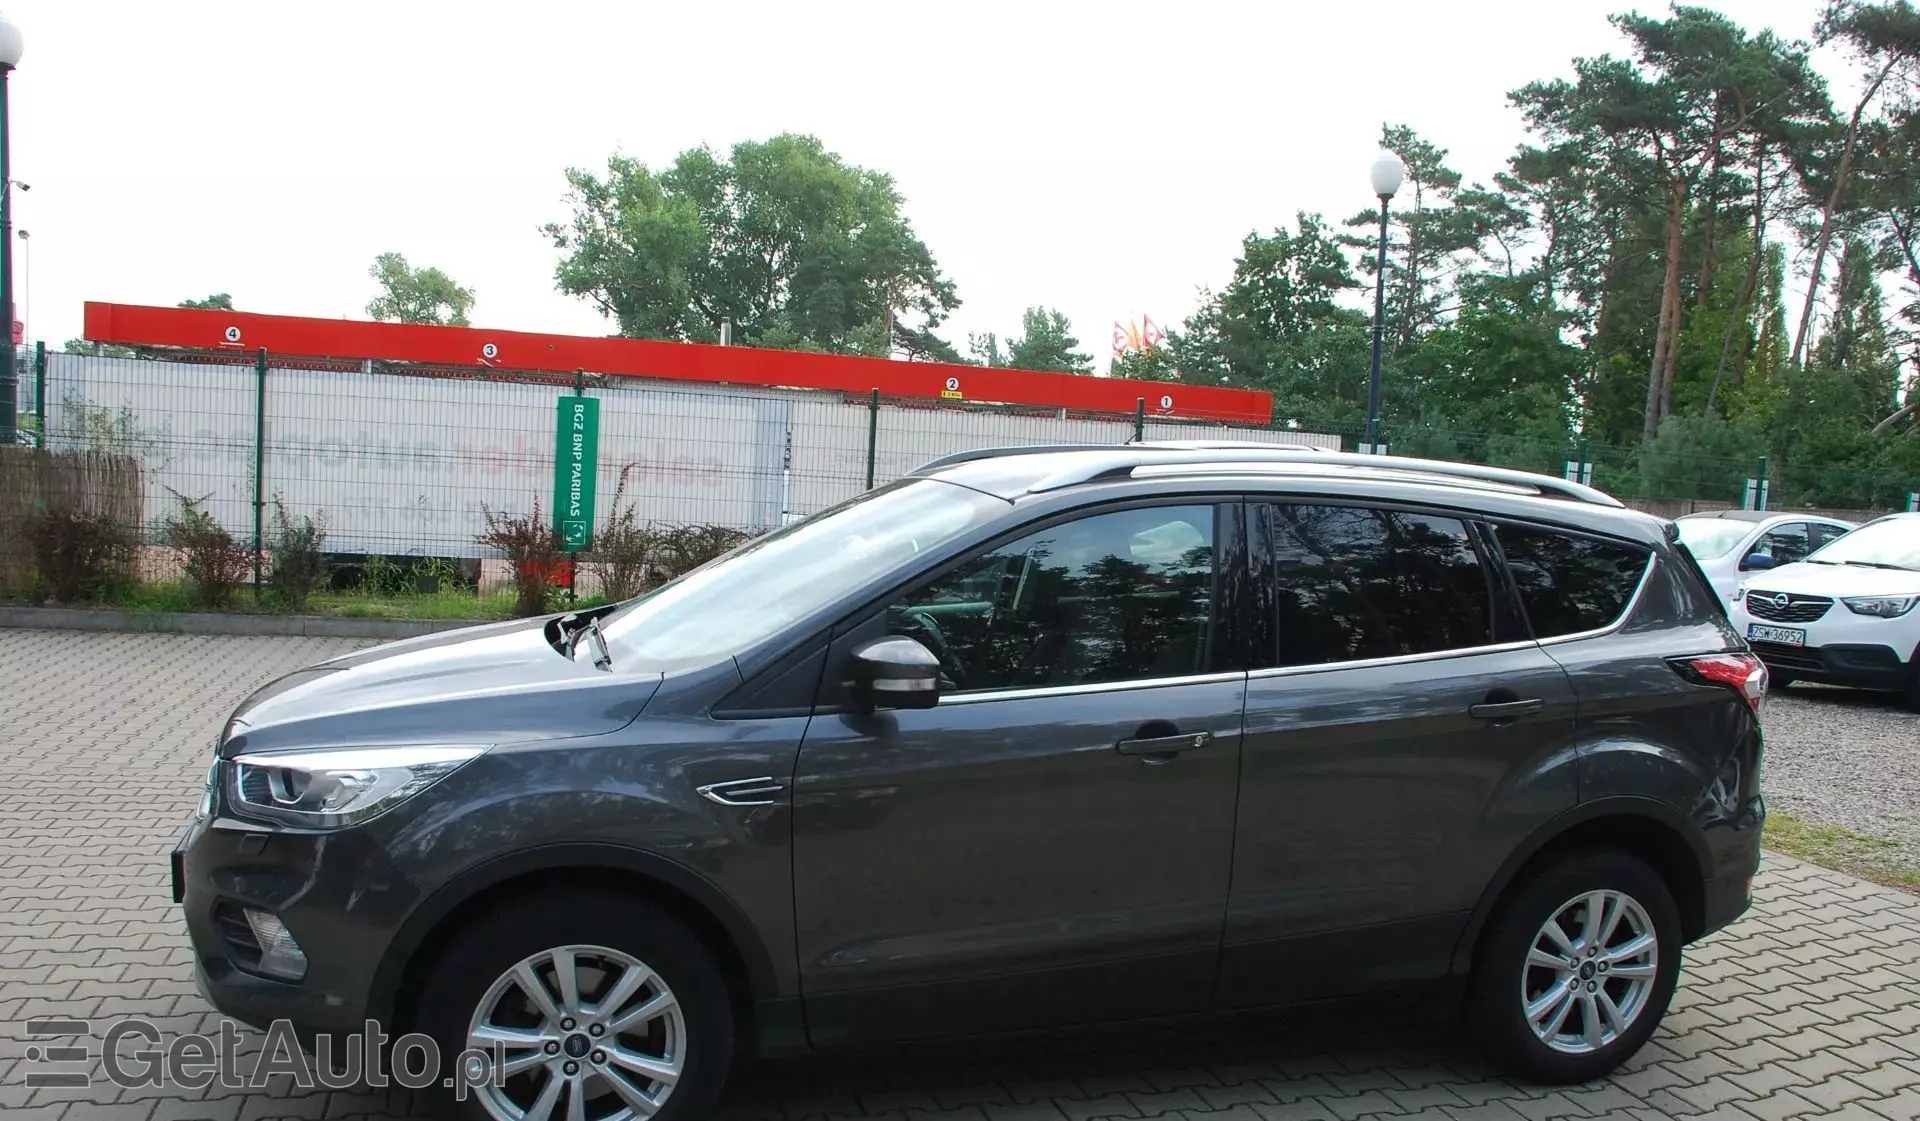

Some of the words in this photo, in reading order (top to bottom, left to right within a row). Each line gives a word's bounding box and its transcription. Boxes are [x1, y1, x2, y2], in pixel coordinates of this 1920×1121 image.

[228, 328, 237, 339] 4
[486, 345, 494, 356] 3
[949, 379, 956, 389] 2
[573, 433, 583, 461] BNP
[570, 463, 582, 517] PARIBAS
[1773, 629, 1803, 643] 36952
